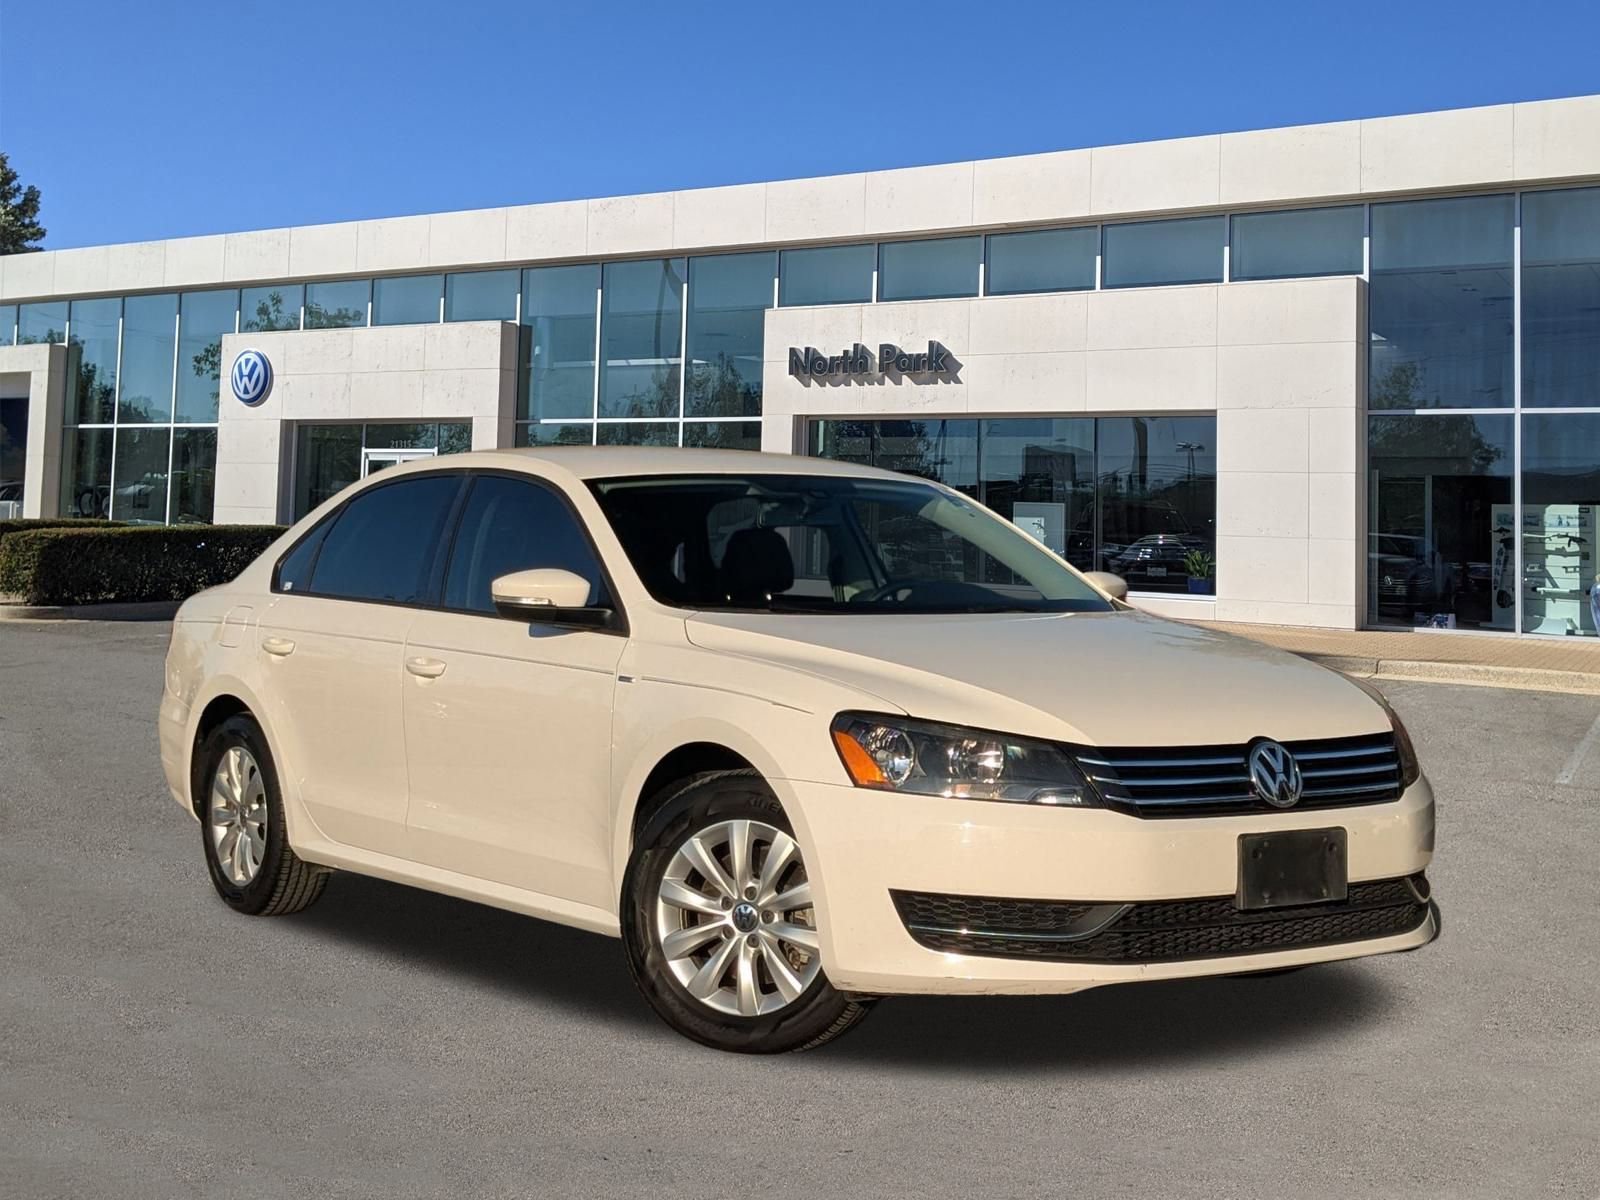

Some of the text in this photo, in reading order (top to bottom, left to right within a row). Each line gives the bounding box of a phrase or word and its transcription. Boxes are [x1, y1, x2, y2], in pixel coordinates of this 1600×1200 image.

[789, 340, 947, 375] North Park
[390, 440, 412, 449] 21315
